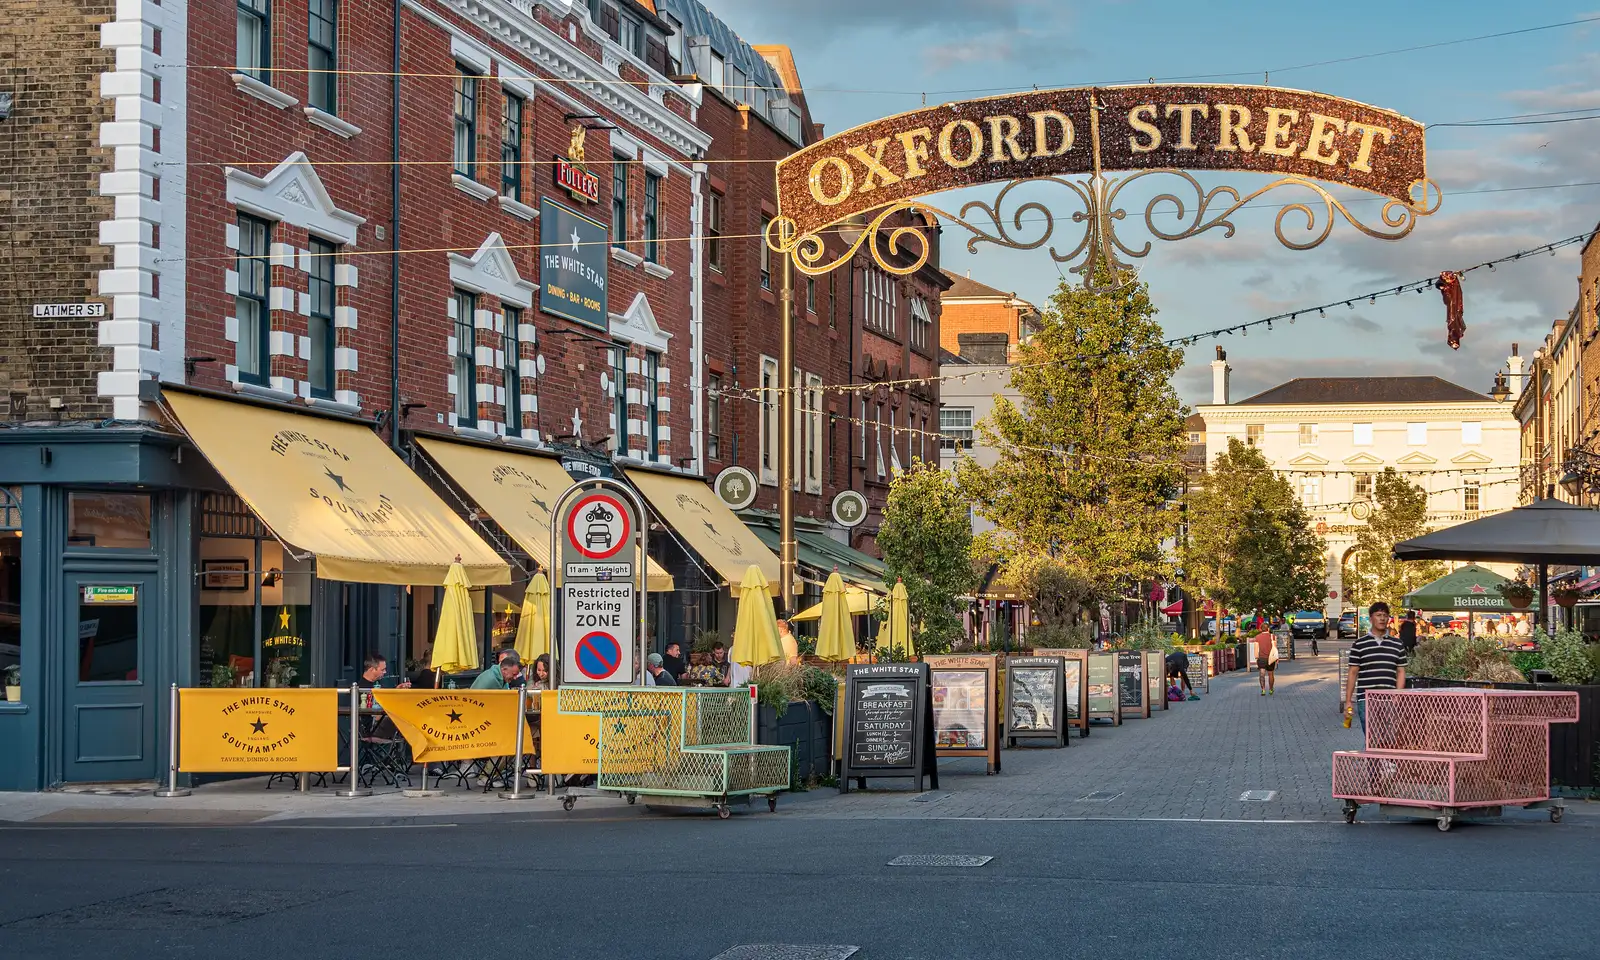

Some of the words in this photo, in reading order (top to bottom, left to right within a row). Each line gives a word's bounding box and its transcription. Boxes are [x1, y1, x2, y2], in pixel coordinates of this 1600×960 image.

[808, 110, 1075, 206] OXFORD
[1128, 103, 1392, 173] STREET
[561, 163, 598, 198] FULLER'S
[545, 255, 559, 269] THE
[561, 255, 585, 276] WHITE
[586, 267, 604, 291] STAR
[547, 284, 565, 299] DINING
[570, 291, 580, 304] BAR
[583, 297, 601, 312] ROOMS
[36, 305, 83, 316] LATIMER
[87, 305, 102, 315] ST
[279, 430, 314, 446] WHITE
[271, 434, 288, 457] THE
[562, 462, 572, 471] THE
[572, 461, 588, 473] WHITE
[588, 464, 602, 478] STAR
[568, 587, 630, 598] Restricted
[577, 600, 621, 612] Parking
[1453, 596, 1504, 606] Heineken
[576, 614, 621, 627] ZONE
[274, 636, 292, 645] WHITE
[970, 658, 986, 667] STAR
[222, 701, 240, 715] THE
[241, 696, 271, 706] WHITE
[273, 700, 296, 716] STAR
[416, 698, 432, 709] THE
[462, 697, 485, 708] STAR
[863, 701, 908, 709] BREAKFAST
[421, 719, 492, 741] SOUTHAMPTON
[864, 722, 906, 730] SATURDAY
[222, 731, 296, 754] SOUTHAMPTON
